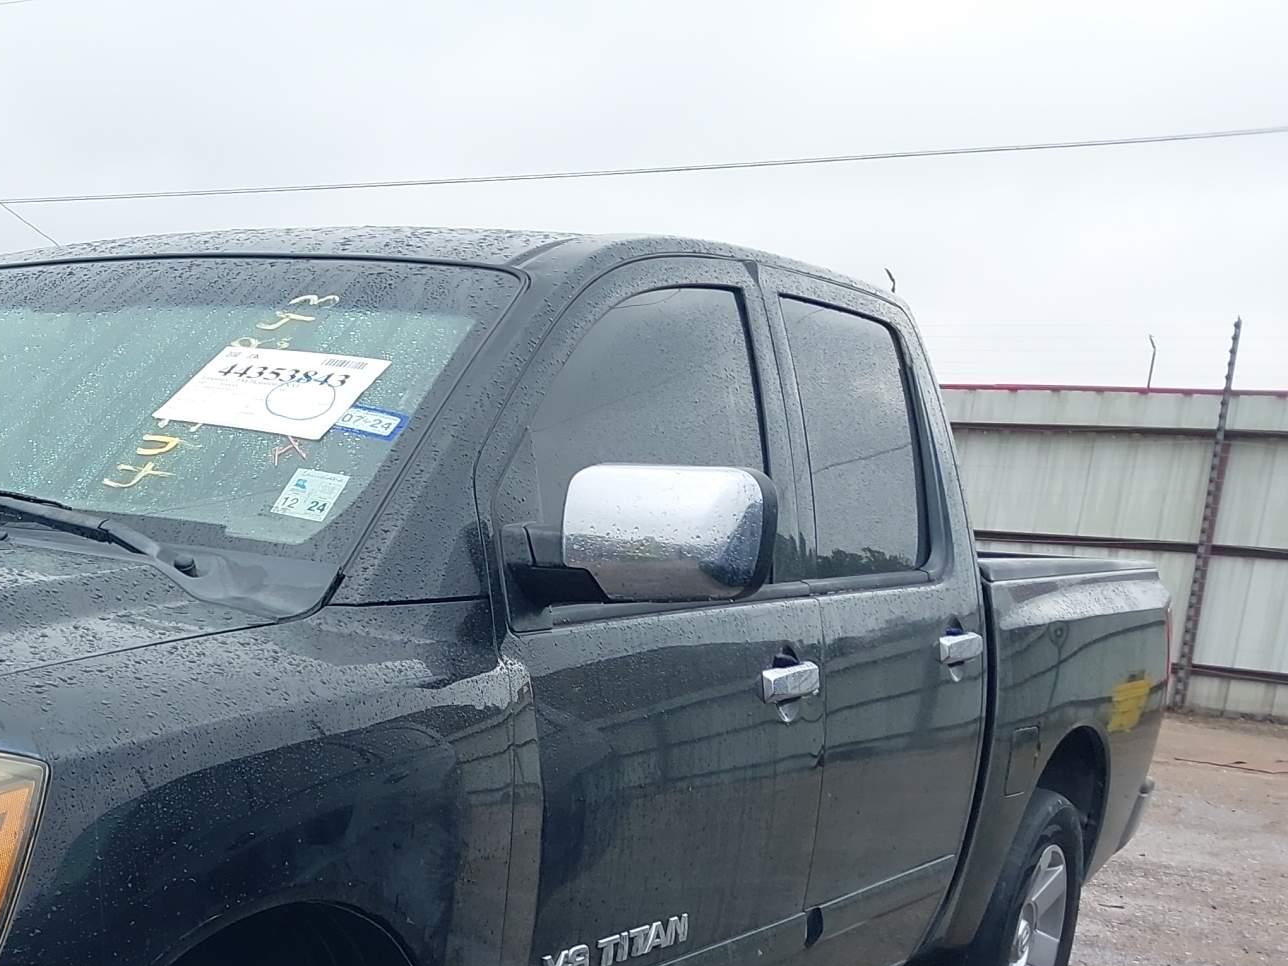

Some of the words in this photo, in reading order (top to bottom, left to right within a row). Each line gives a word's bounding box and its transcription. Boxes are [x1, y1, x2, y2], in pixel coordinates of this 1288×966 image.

[218, 363, 351, 388] 44353843
[281, 496, 300, 509] 12
[306, 500, 328, 513] 24
